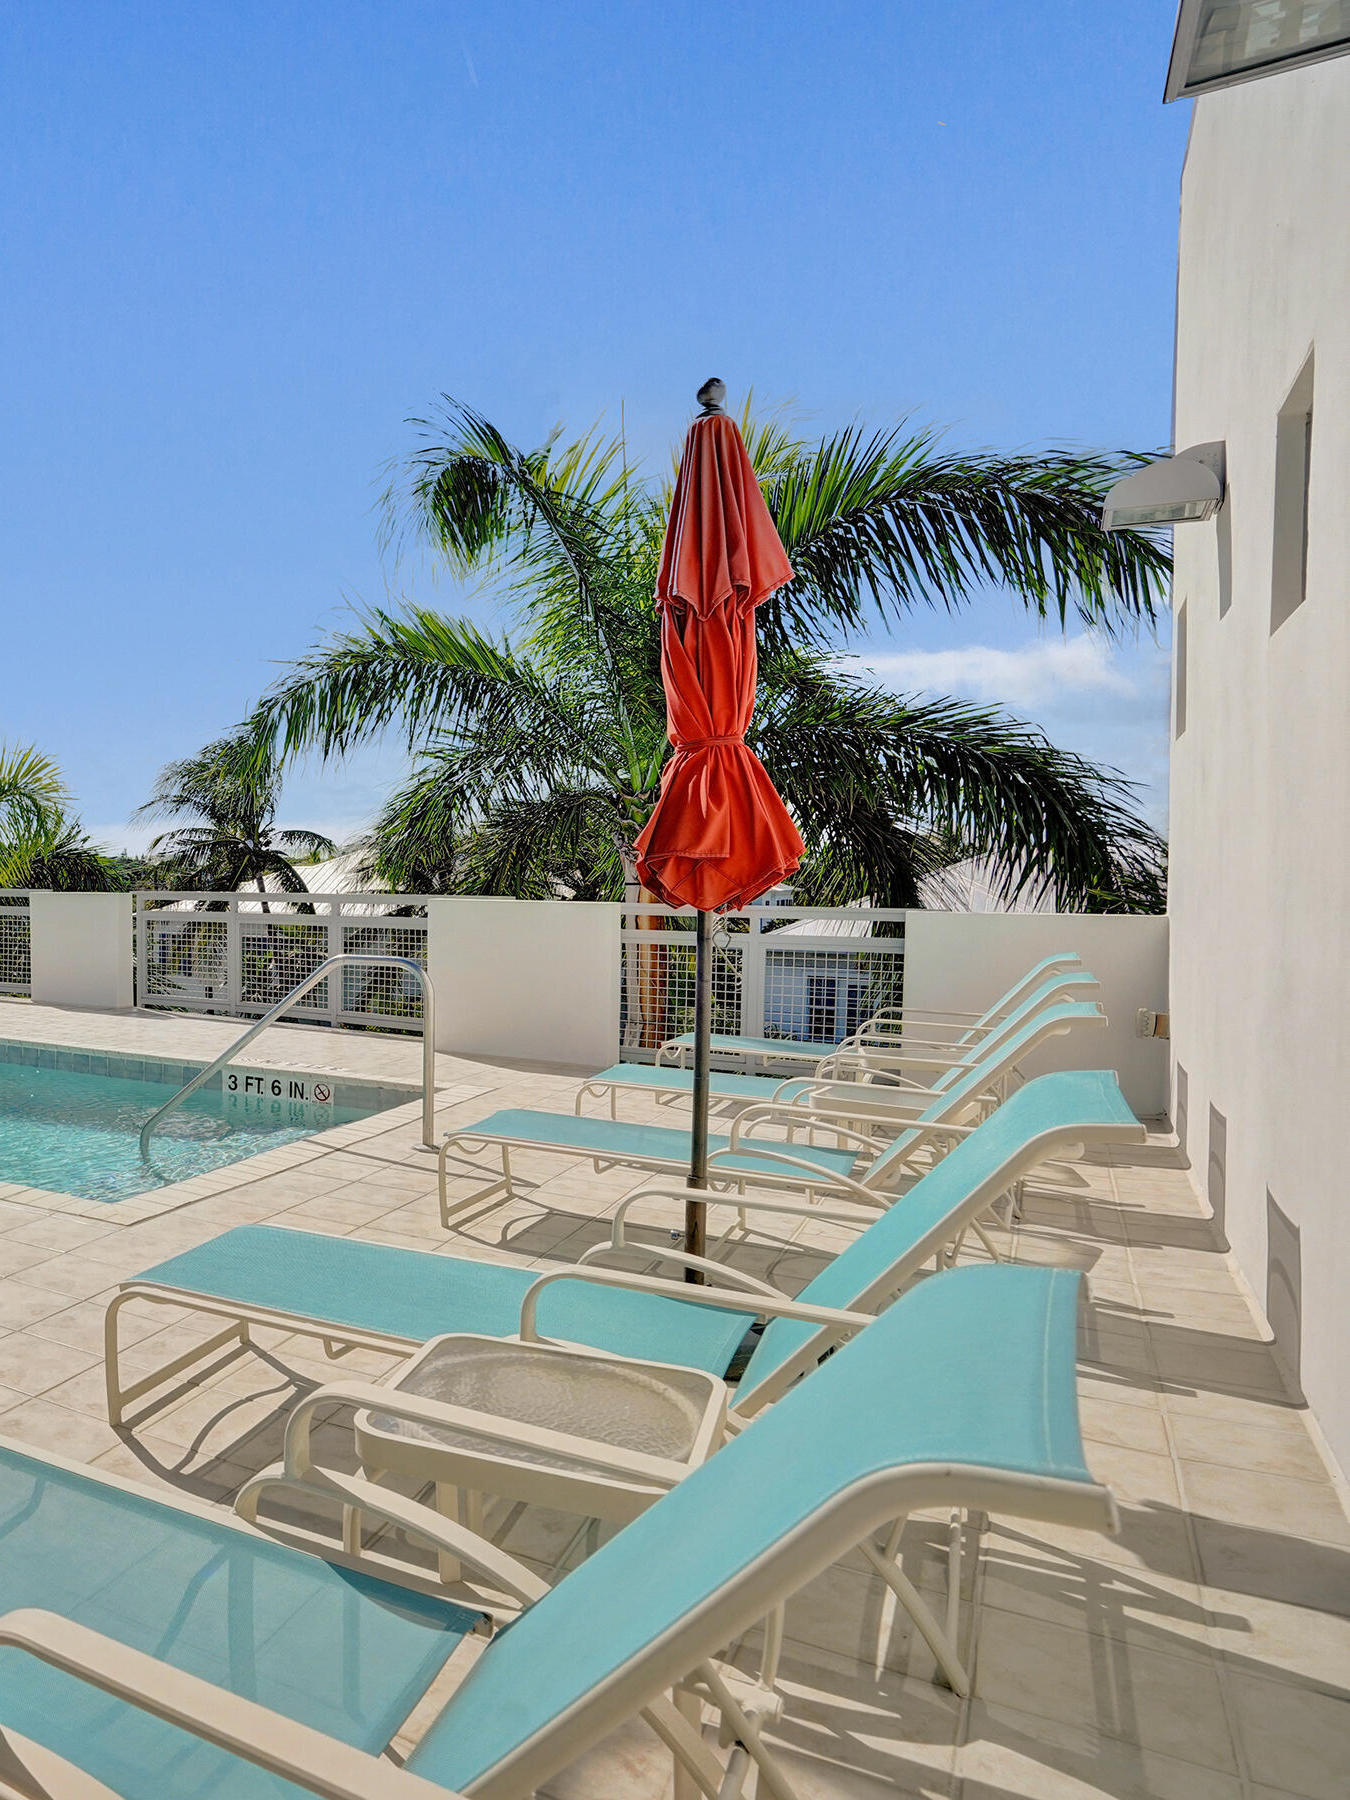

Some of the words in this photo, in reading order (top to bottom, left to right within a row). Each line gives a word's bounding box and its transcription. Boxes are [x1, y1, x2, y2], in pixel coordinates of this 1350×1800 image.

[228, 1074, 238, 1091] 3
[245, 1076, 264, 1095] FT.
[271, 1079, 282, 1097] 6
[289, 1081, 309, 1100] IN.
